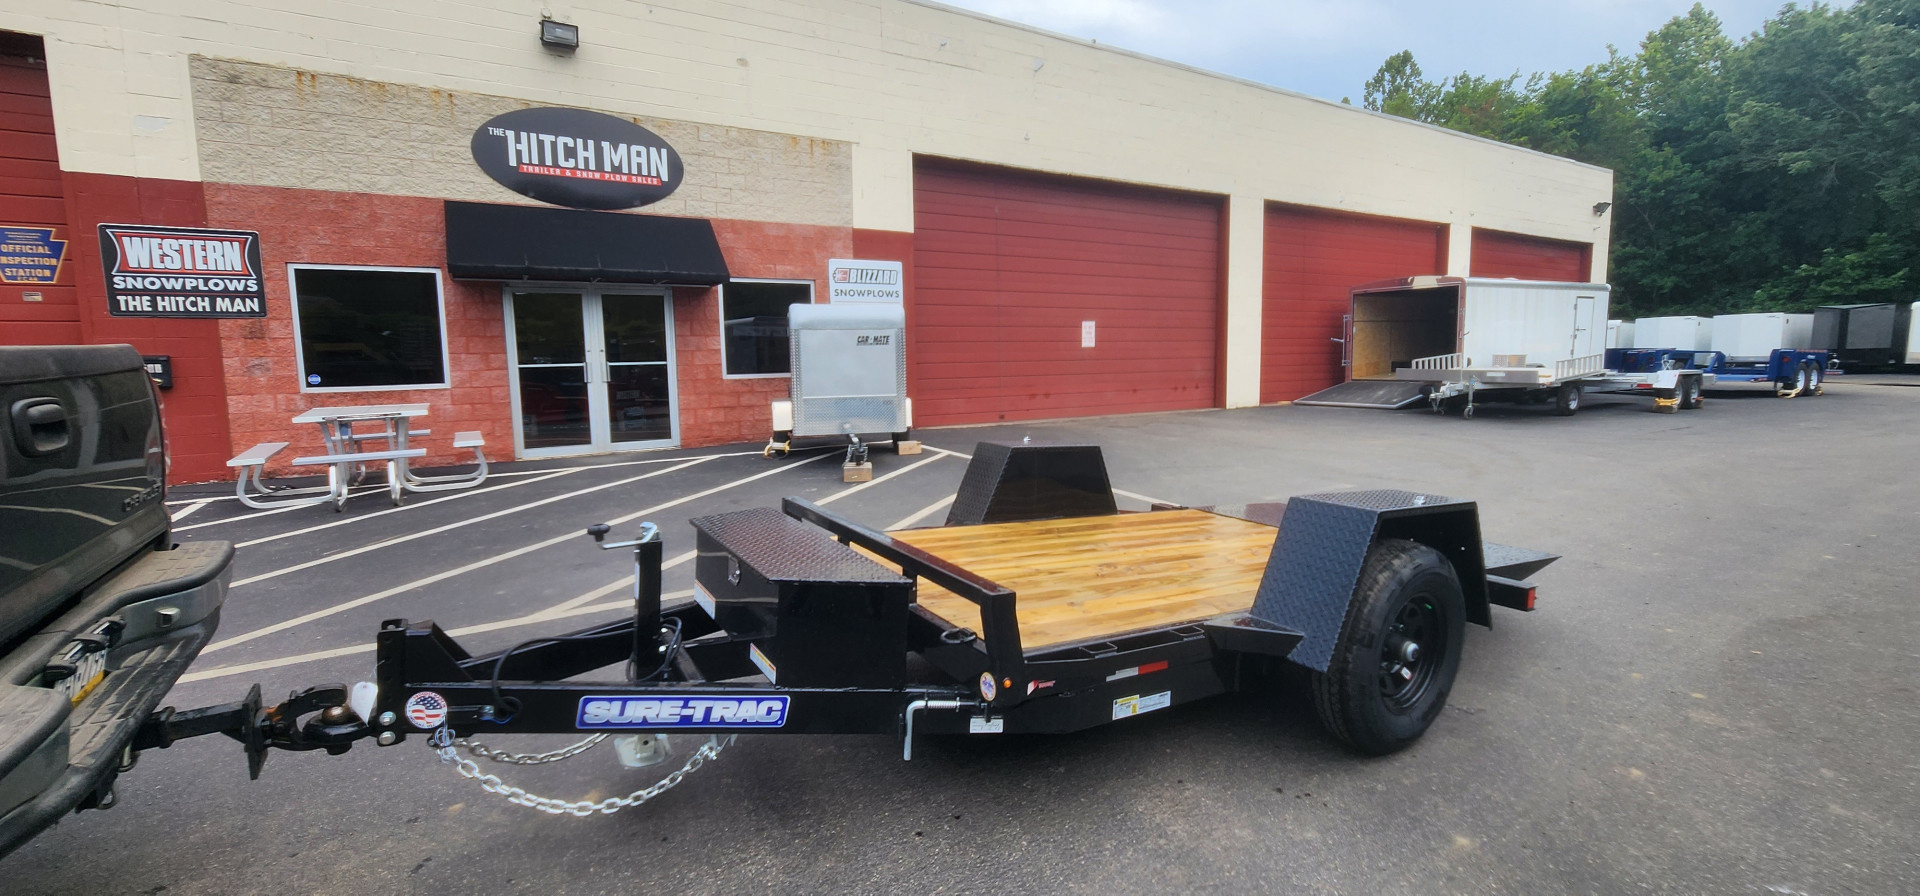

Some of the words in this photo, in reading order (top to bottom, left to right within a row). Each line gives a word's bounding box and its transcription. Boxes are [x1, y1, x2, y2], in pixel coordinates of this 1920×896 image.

[487, 126, 505, 137] THE
[506, 130, 595, 170] HITCH
[601, 140, 669, 182] MAN
[522, 165, 560, 175] TRAILER
[565, 169, 572, 177] &
[576, 170, 601, 179] SNOW
[605, 173, 628, 181] PLOW
[631, 175, 658, 185] SALES
[0, 244, 52, 254] OFFICIAL
[121, 236, 243, 272] WESTERN
[0, 255, 58, 266] NSPECTION
[4, 267, 51, 277] STATION
[849, 268, 898, 285] BLIZZARD
[112, 276, 259, 292] SNOWPLOWS
[834, 289, 899, 298] SNOWPLOWS
[116, 295, 153, 312] THE
[157, 296, 210, 312] HITCH
[215, 297, 260, 313] MAN
[583, 699, 783, 724] SURE-TRAC
